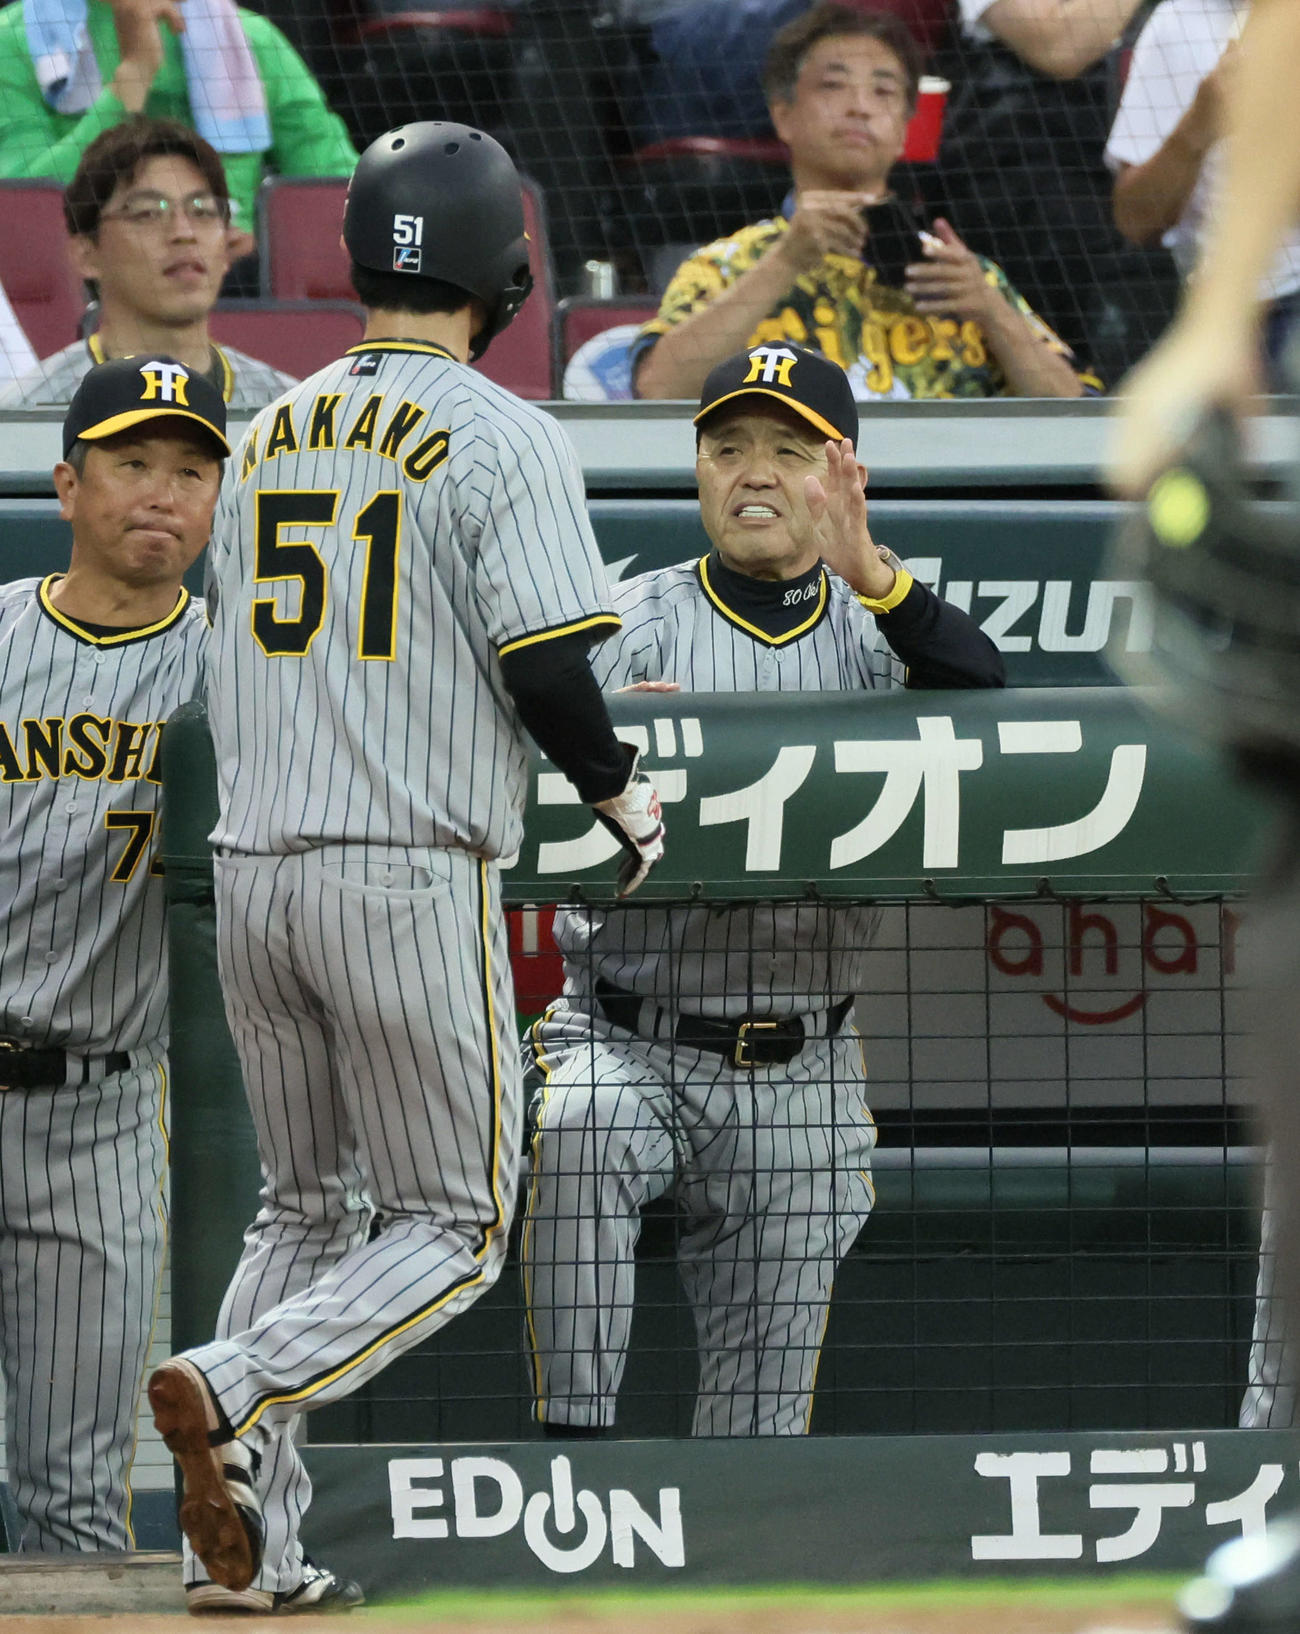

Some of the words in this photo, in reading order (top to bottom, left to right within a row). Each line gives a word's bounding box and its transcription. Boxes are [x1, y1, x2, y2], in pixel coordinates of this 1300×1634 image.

[393, 214, 424, 246] 51
[250, 489, 402, 662] 51
[782, 588, 803, 606] 80
[104, 810, 165, 882] 7
[497, 714, 1147, 875] ディオン
[388, 1454, 686, 1574] EDION
[971, 1441, 1300, 1562] エディ
